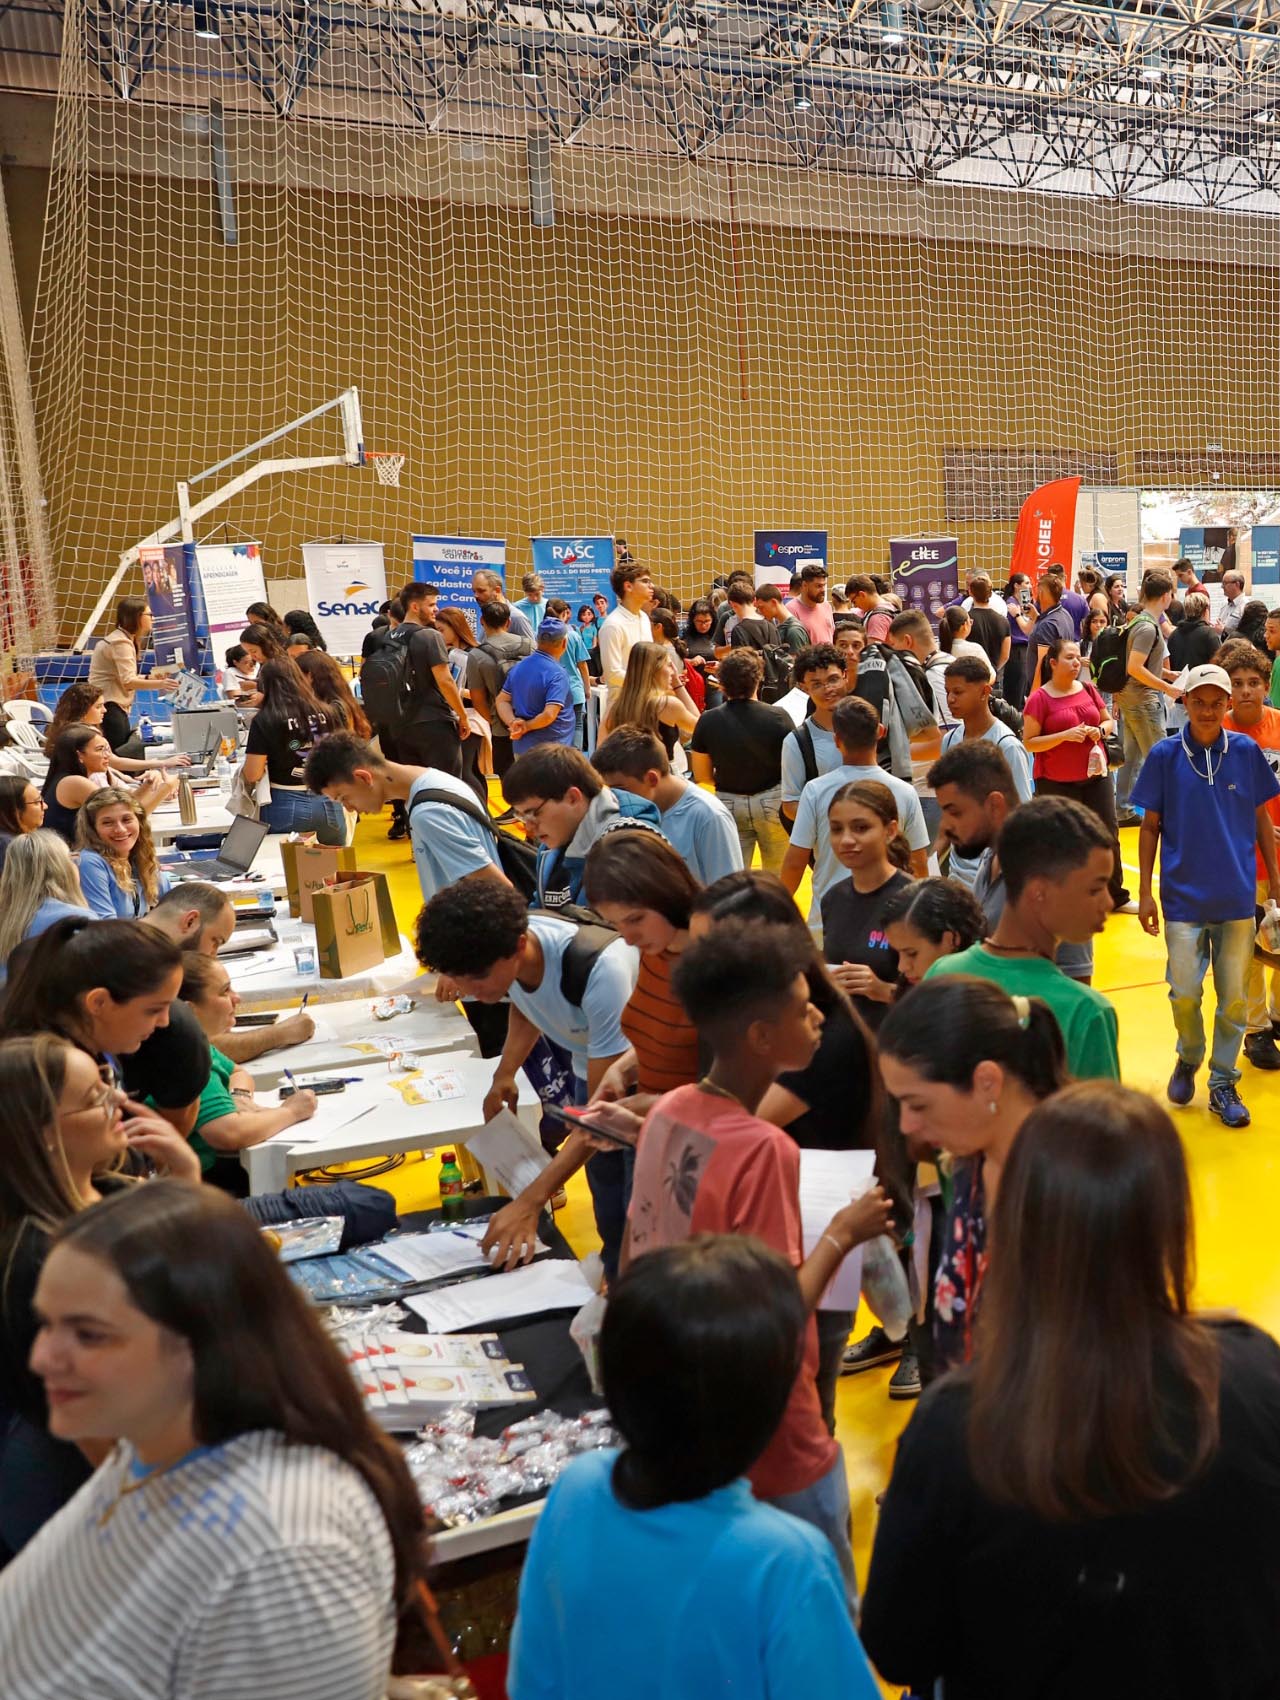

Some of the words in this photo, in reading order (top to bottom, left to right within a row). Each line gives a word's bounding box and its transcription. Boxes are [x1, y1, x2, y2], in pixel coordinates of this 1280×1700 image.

[552, 545, 595, 559] RASC
[777, 544, 804, 556] espro
[433, 564, 461, 575] Você
[461, 566, 473, 578] já
[317, 600, 380, 617] Senac
